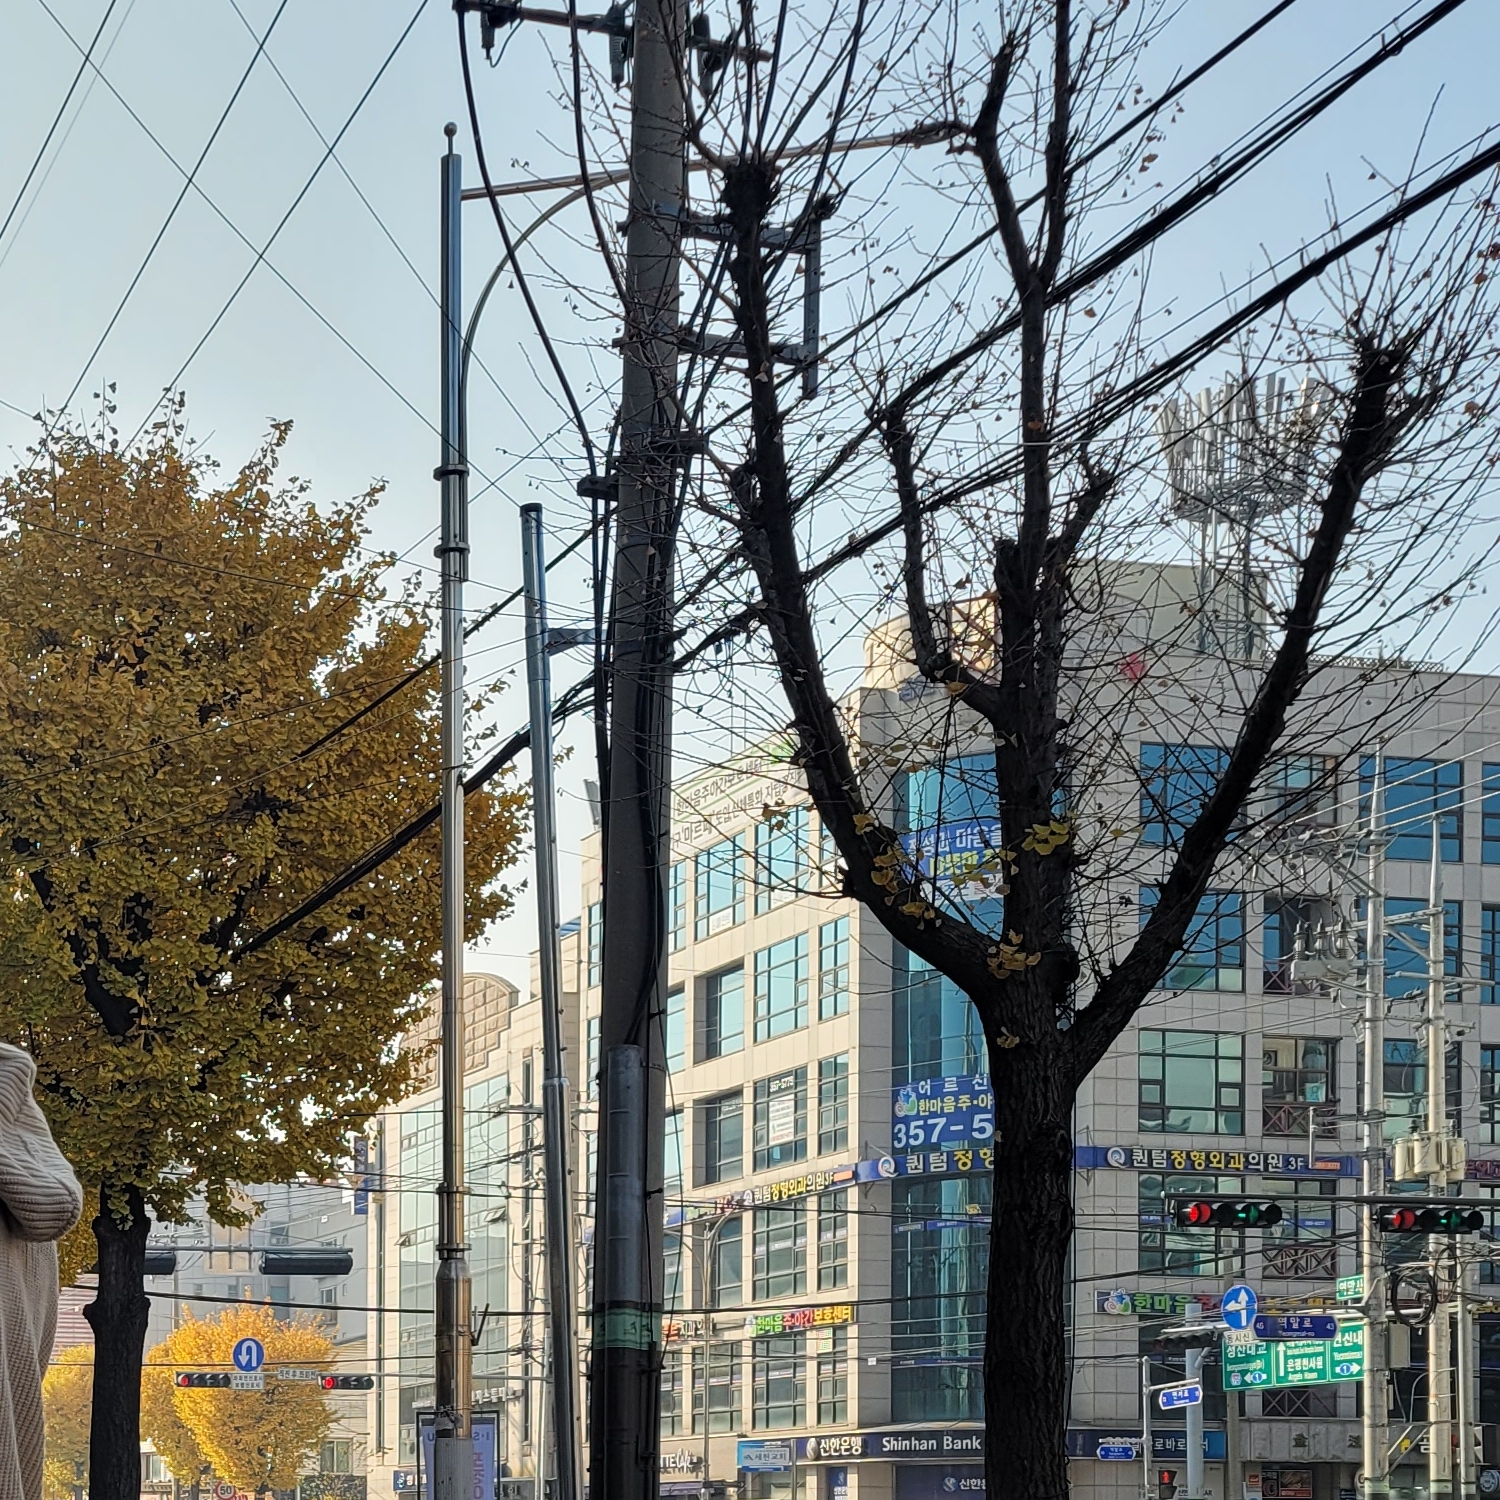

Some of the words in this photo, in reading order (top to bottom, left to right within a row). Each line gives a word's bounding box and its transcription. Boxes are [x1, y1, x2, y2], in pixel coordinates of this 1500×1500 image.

[1131, 1148, 1283, 1172] 퀀텀정형외과의원
[1288, 1155, 1305, 1170] 3F
[1278, 1316, 1313, 1329] 역말로
[1226, 1341, 1268, 1358] 성산대교
[819, 1437, 862, 1456] 신한은행
[882, 1436, 937, 1452] Shinhan
[943, 1436, 982, 1450] Bank
[220, 1485, 232, 1495] 50
